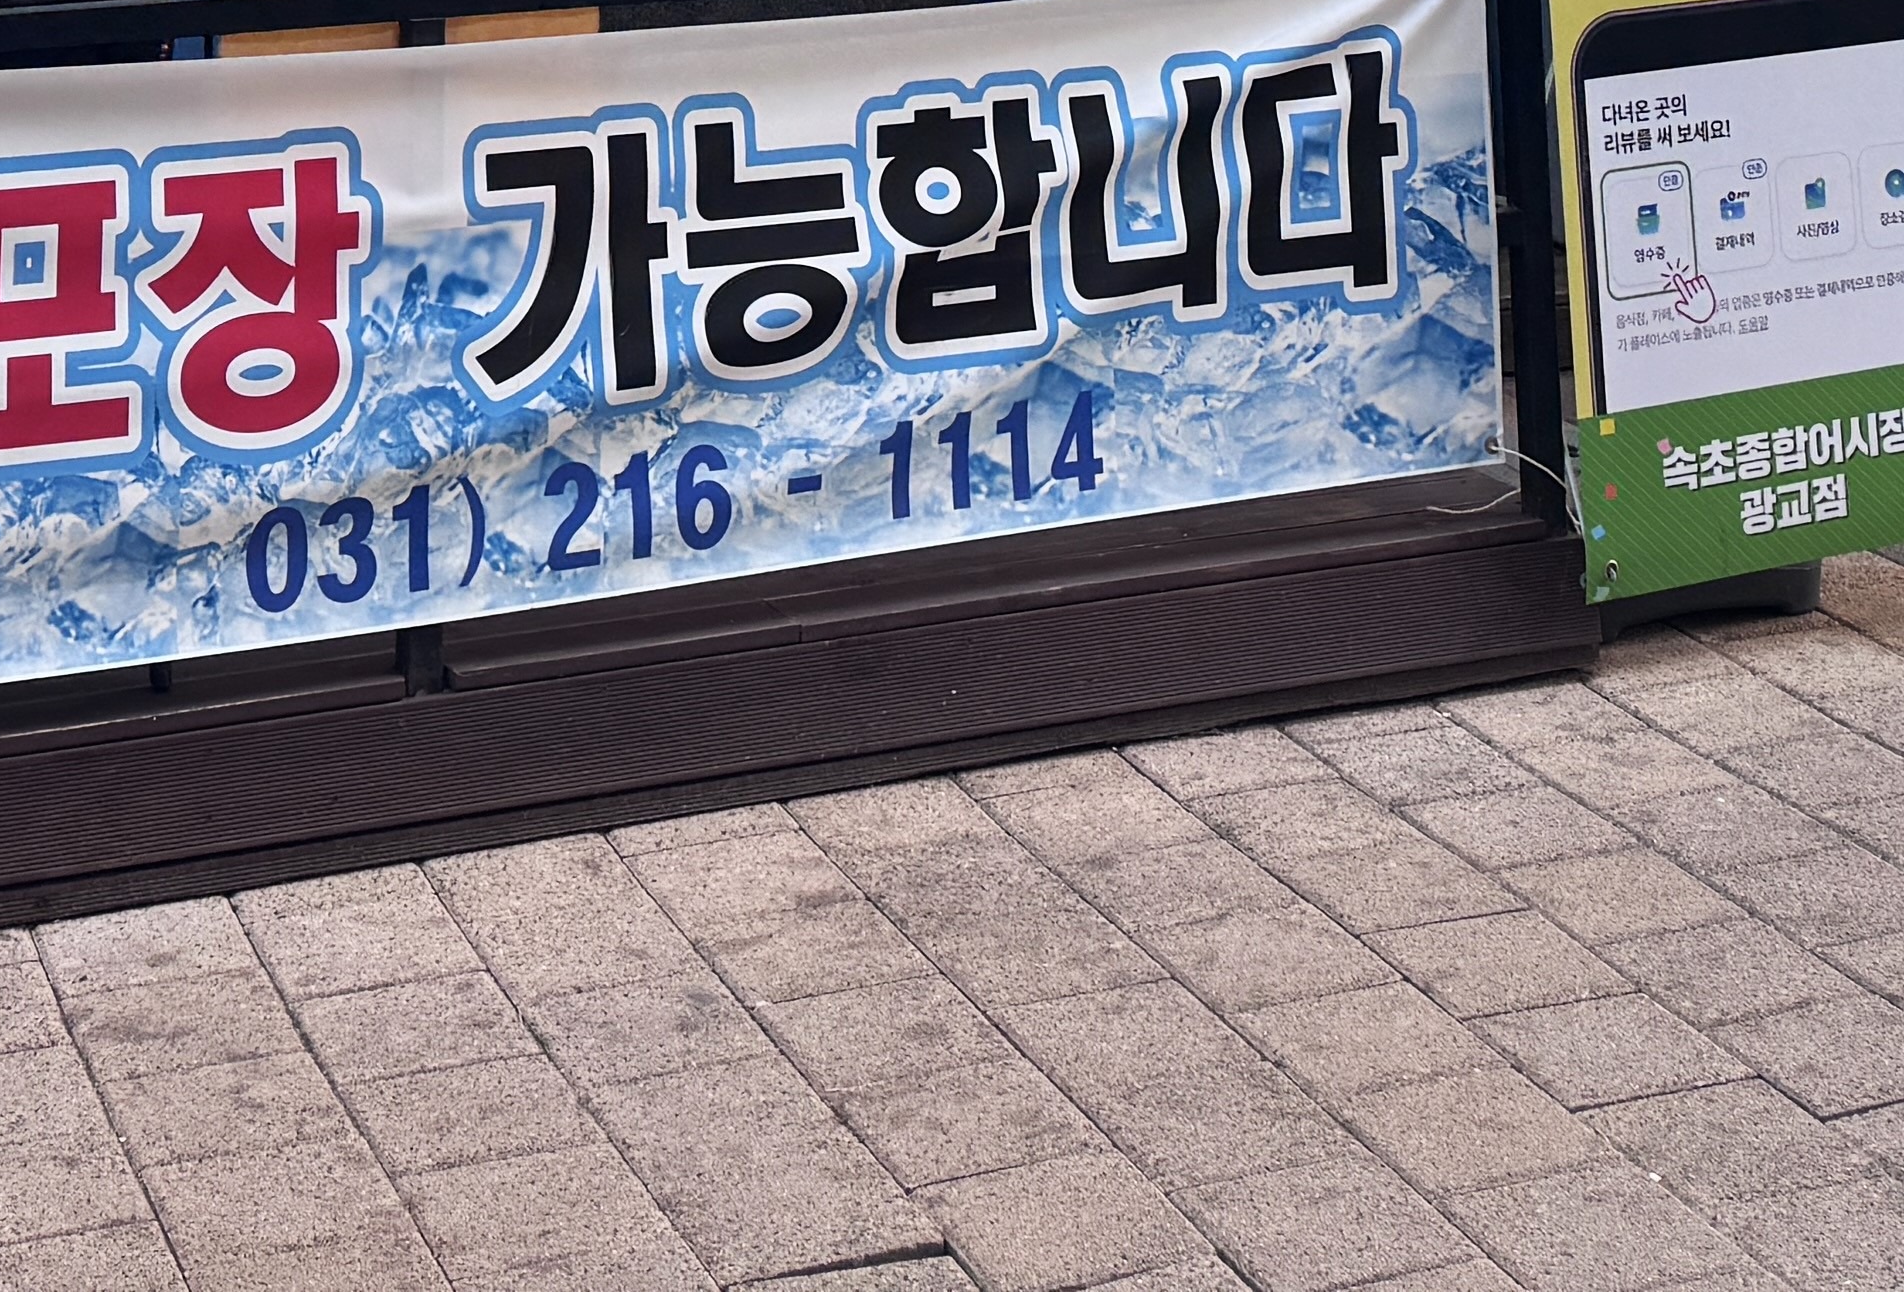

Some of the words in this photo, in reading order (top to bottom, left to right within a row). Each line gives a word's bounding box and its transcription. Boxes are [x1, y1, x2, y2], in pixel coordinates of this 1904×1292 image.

[1601, 100, 1651, 126] 다녀온
[1655, 94, 1688, 119] 곳의
[1603, 129, 1653, 155] 리뷰를
[1658, 125, 1673, 149] 써
[1677, 119, 1731, 145] 보세요!
[468, 48, 1406, 405] 가능합니다
[243, 477, 488, 617] 031)
[546, 439, 737, 577] 216
[890, 388, 1105, 523] 1114
[1739, 474, 1850, 536] 광교점
